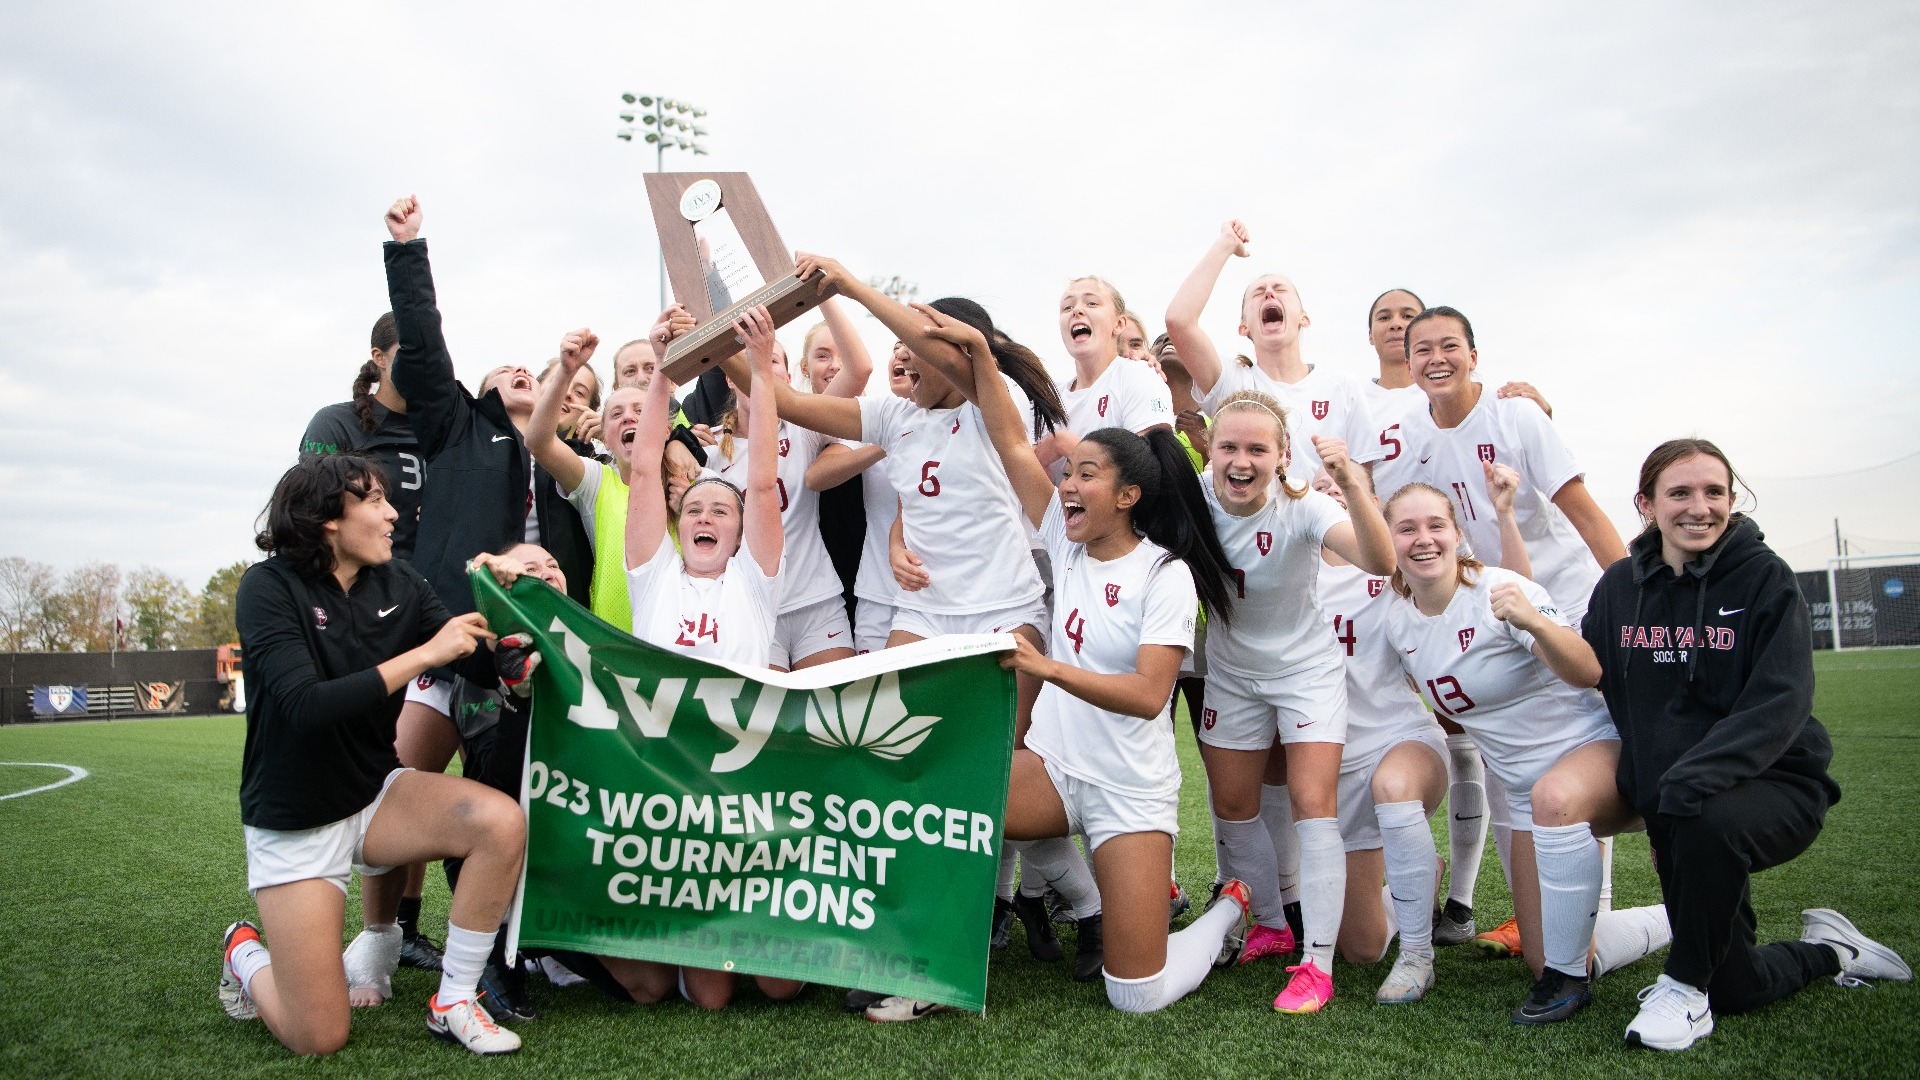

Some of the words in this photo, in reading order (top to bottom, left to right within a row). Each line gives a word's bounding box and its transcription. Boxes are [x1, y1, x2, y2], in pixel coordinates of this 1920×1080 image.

[698, 314, 733, 337] HARVARD
[733, 287, 777, 316] UNIVERSITY
[304, 440, 324, 455] Ivy
[1380, 424, 1401, 461] 5
[398, 452, 428, 491] 3
[918, 460, 941, 498] 6
[1451, 481, 1477, 521] 11
[675, 612, 719, 647] 24
[1065, 607, 1085, 654] 4
[1334, 614, 1357, 656] 4
[1620, 625, 1735, 651] HARVARD
[1653, 650, 1688, 663] SOCCR
[148, 681, 171, 710] P
[549, 615, 789, 773] Ivy
[1426, 675, 1476, 716] 13
[529, 760, 591, 816] 023
[598, 787, 815, 835] WOMEN'S
[823, 793, 995, 857] SOCCER
[585, 827, 897, 886] TOURNAMENT
[607, 871, 877, 930] CHAMPIONS
[534, 908, 721, 948] UNRIVALED
[729, 929, 930, 983] EXPERIENCE
